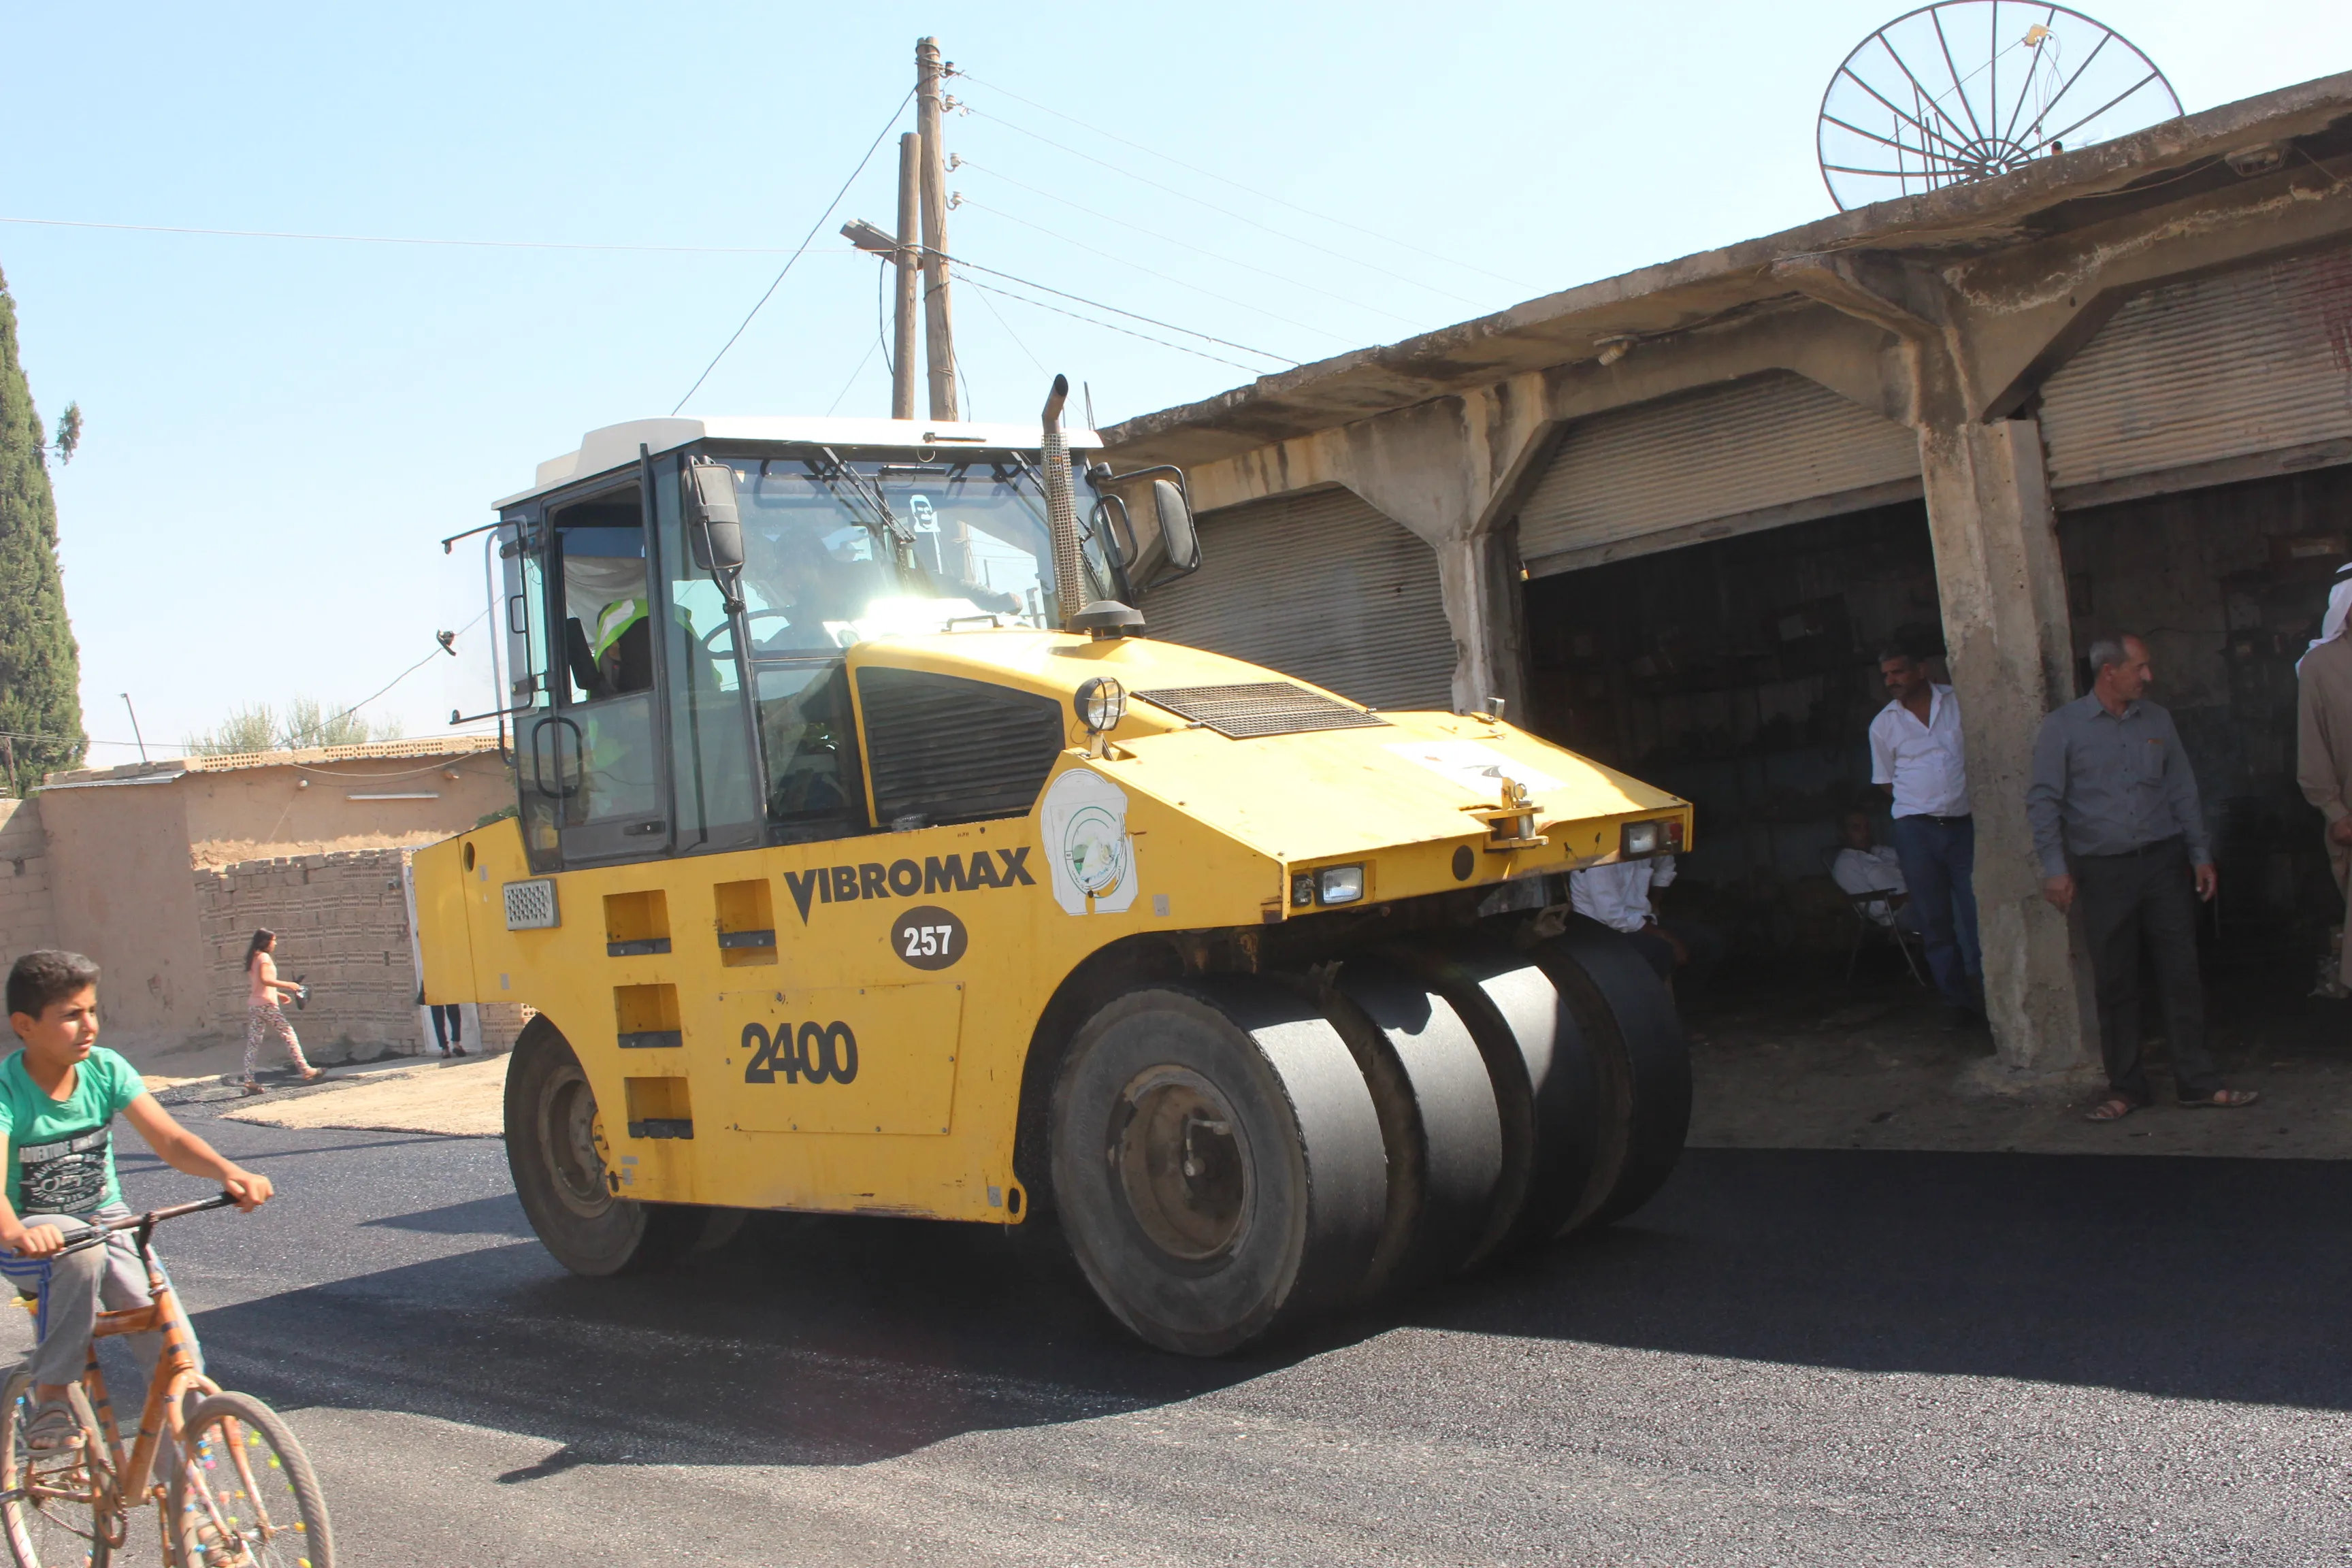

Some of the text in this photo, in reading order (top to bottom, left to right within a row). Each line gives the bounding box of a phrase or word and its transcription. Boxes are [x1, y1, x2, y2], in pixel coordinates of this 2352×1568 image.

[783, 846, 1036, 927] VIBROMAX
[903, 925, 952, 957] 257
[741, 1020, 859, 1085] 2400
